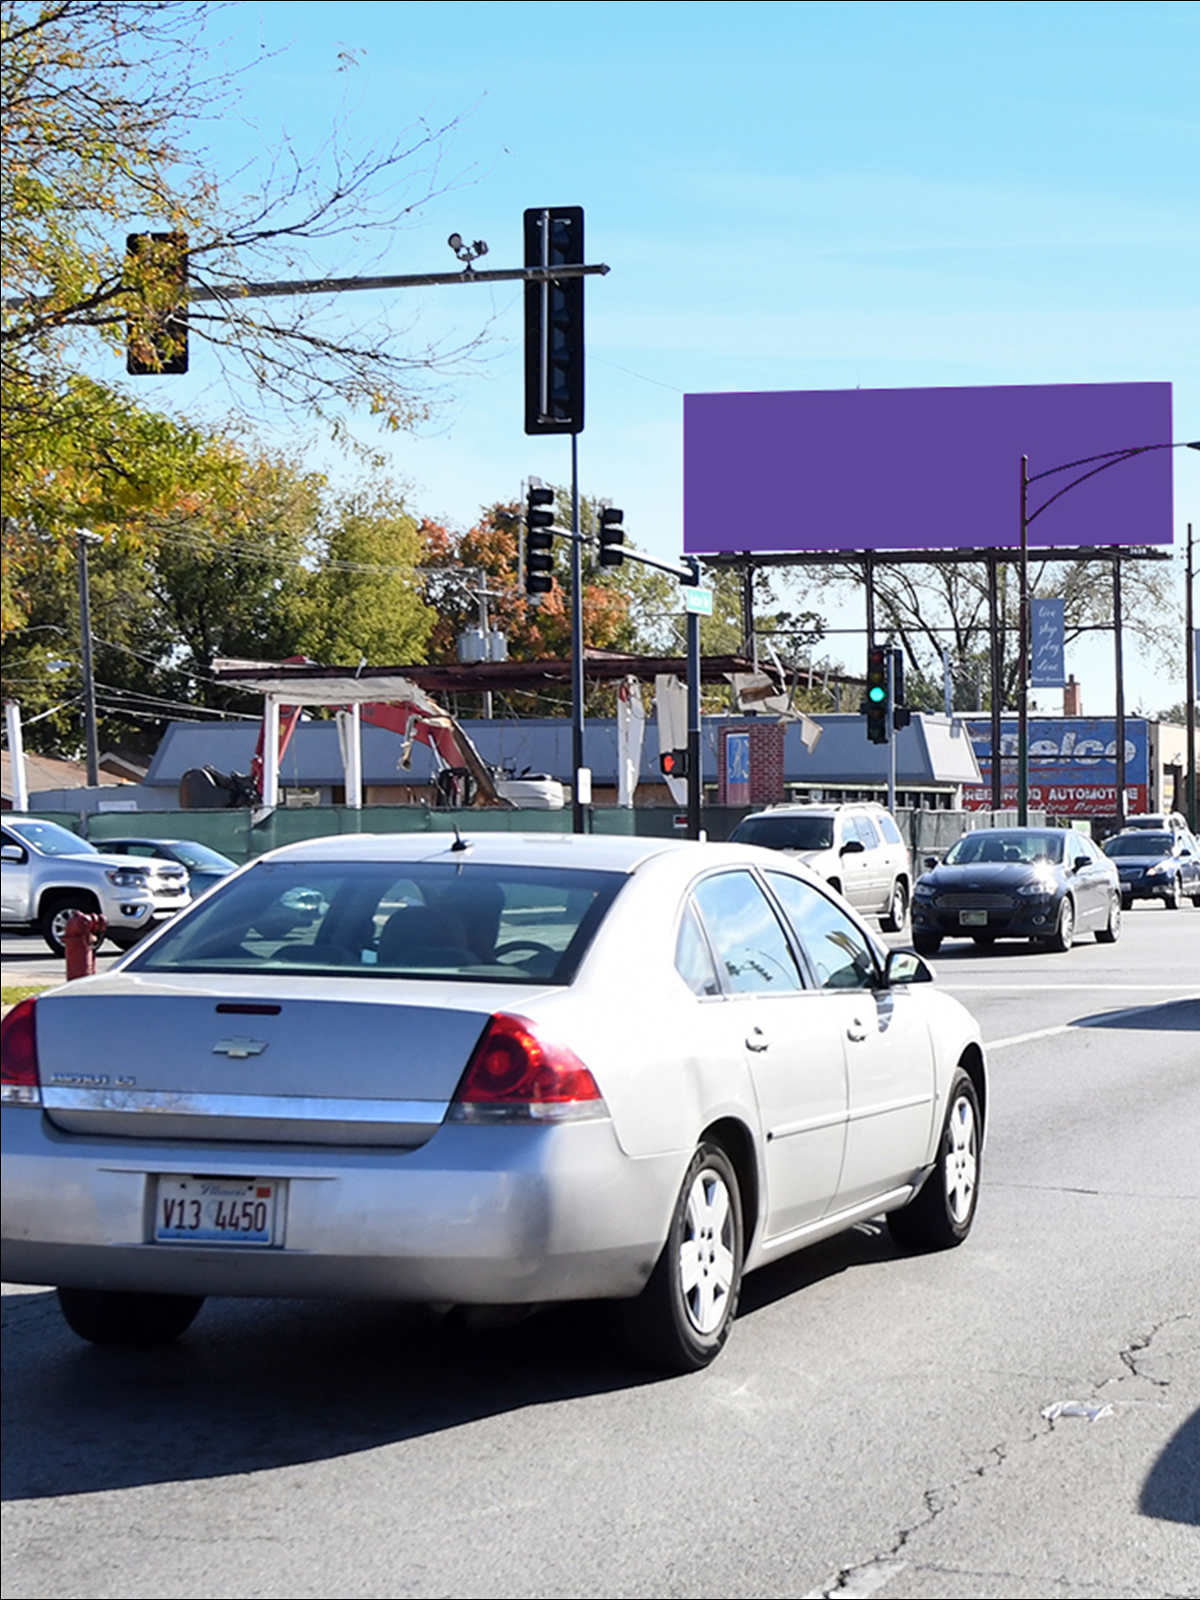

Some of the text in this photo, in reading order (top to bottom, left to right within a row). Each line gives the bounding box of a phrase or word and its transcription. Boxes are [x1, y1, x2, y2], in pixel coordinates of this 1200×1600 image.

[1036, 640, 1061, 658] play
[1036, 658, 1059, 672] dine
[163, 1198, 267, 1232] V13 4450
